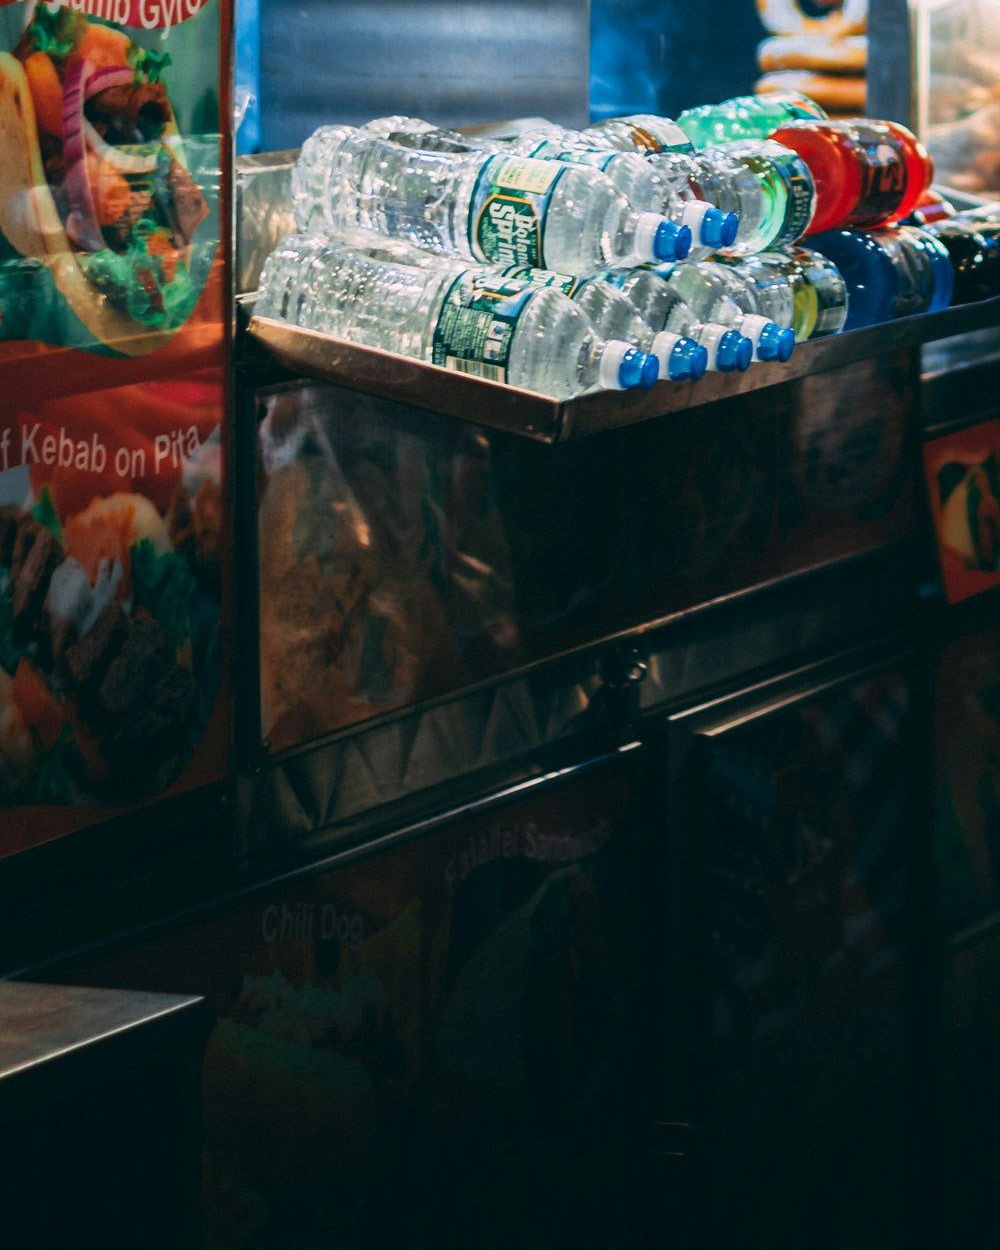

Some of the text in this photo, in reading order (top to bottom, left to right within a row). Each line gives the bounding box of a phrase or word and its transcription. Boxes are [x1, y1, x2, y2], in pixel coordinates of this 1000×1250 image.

[489, 202, 517, 267] Spring
[21, 423, 106, 473] Kebab
[115, 447, 145, 478] on
[155, 425, 200, 474] Pita
[262, 904, 363, 947] Chili Dog
